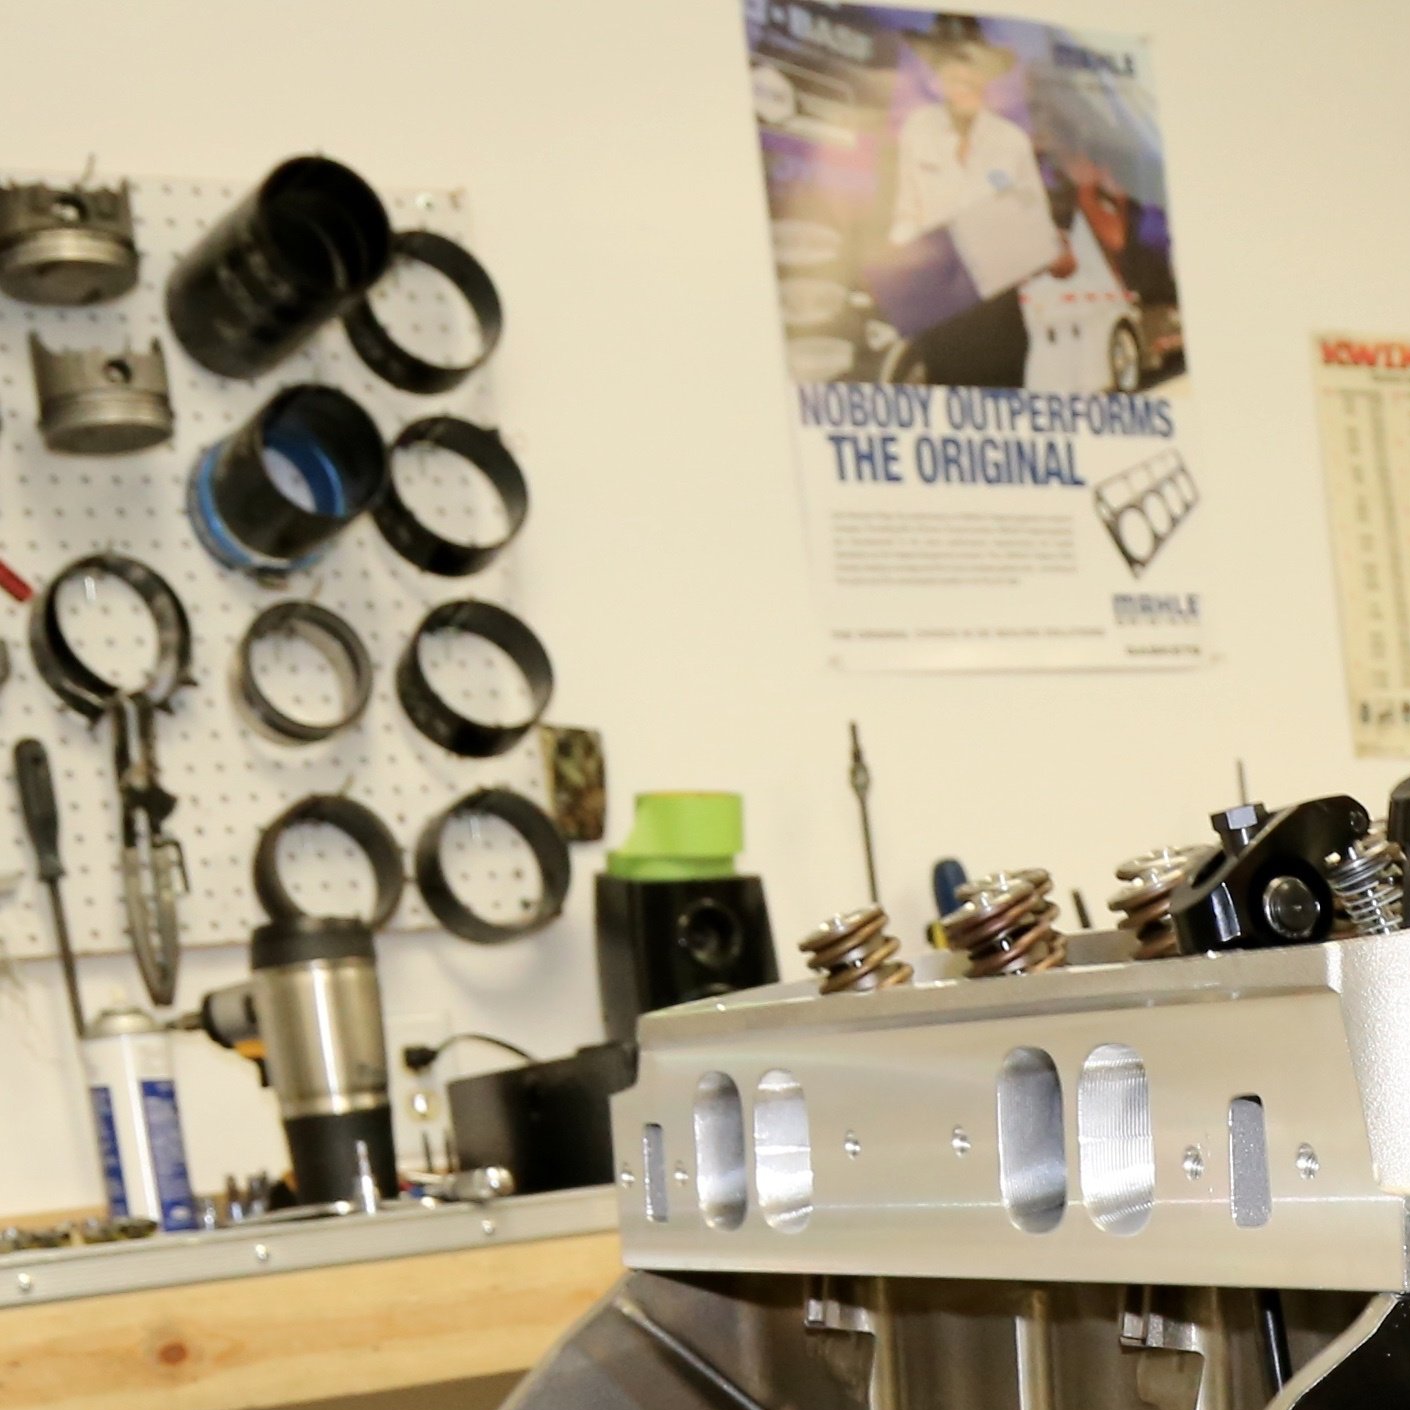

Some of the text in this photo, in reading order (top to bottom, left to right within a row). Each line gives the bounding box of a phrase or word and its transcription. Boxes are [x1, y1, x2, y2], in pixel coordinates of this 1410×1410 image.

[801, 383, 1175, 437] NOBODY OUTPERFORMS
[828, 434, 1087, 487] THE ORIGINAL
